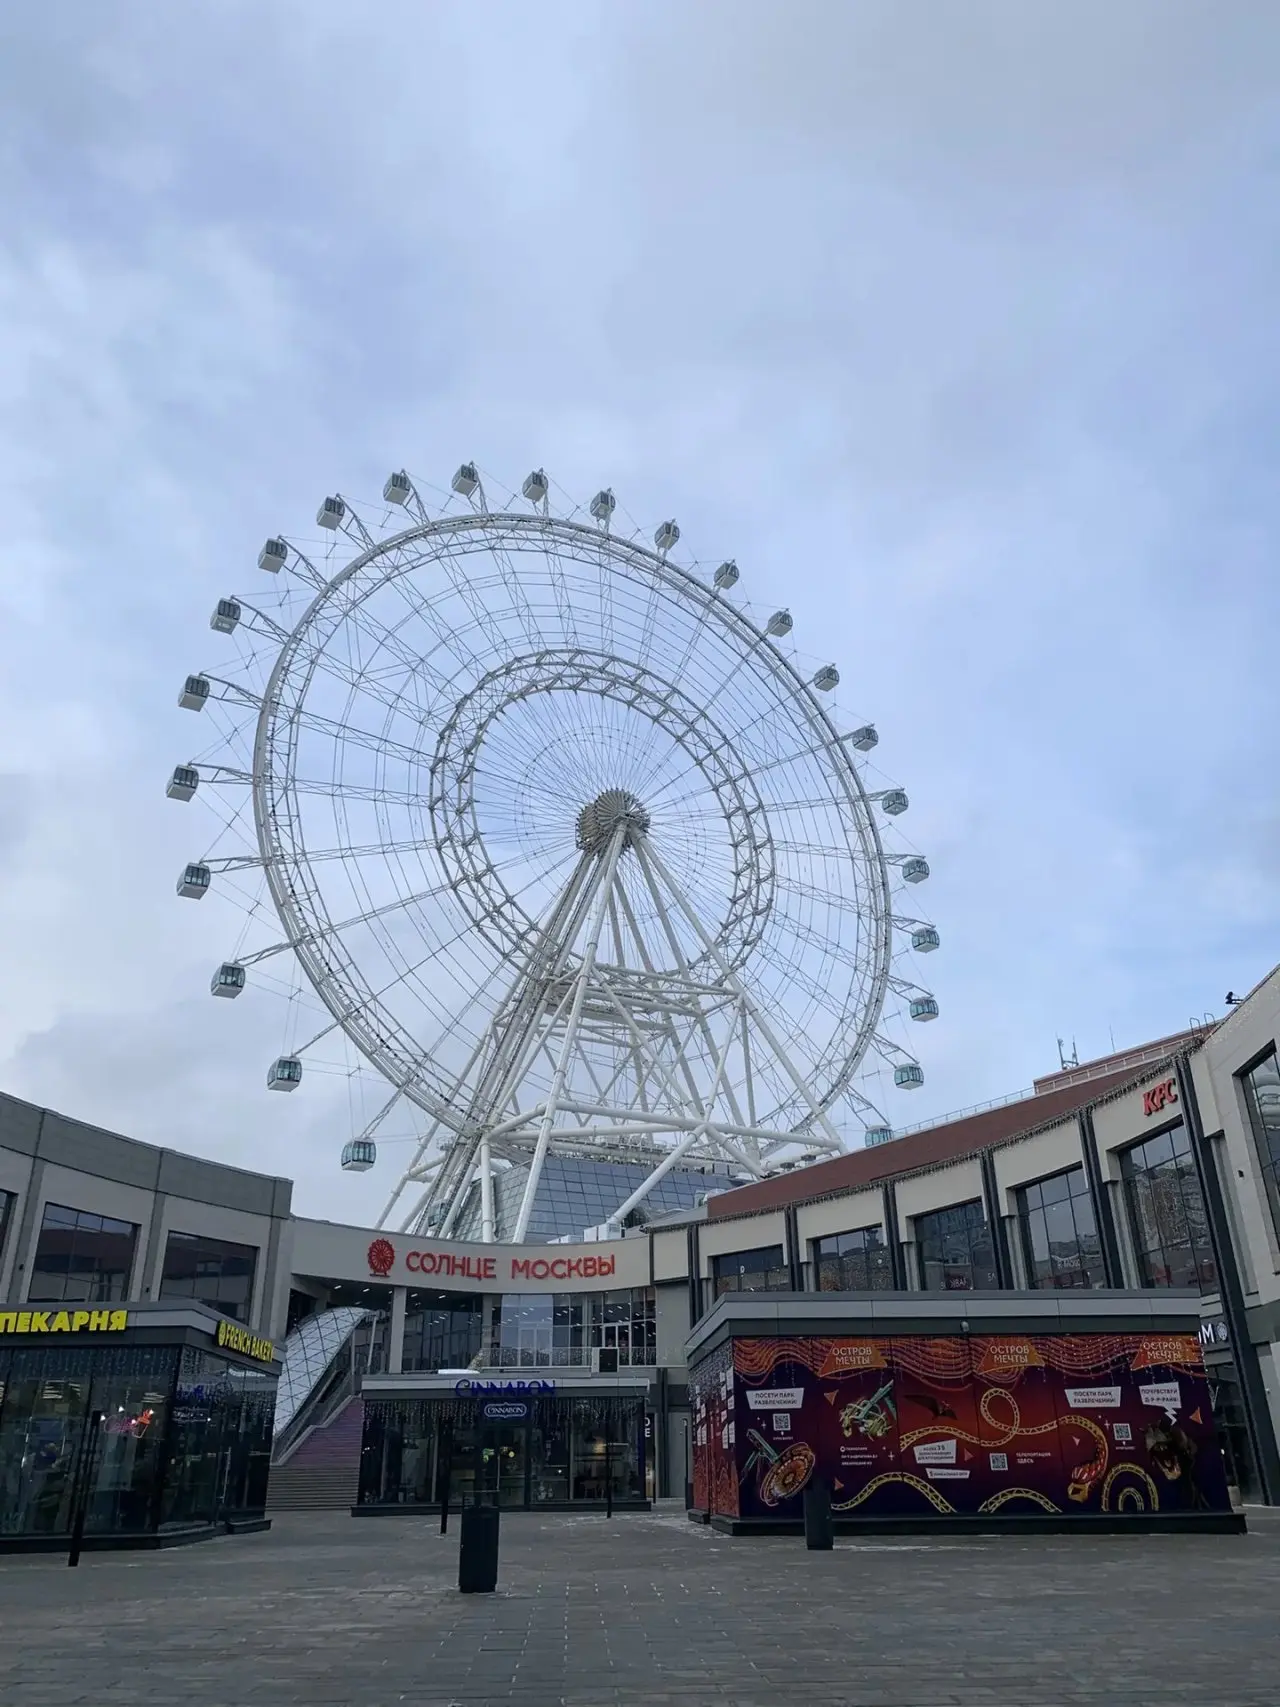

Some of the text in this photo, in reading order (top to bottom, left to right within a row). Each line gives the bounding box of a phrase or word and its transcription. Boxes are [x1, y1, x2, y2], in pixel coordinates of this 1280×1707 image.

[1143, 1078, 1178, 1116] KFC
[405, 1251, 616, 1281] СОЛНЦЕ МОСКВЫ
[0, 1310, 127, 1333] ПЕКАРНЯ
[226, 1326, 273, 1363] FRENCH BAKERY
[1142, 1341, 1182, 1351] ОСТРОВ
[832, 1346, 872, 1356] ОСТРОВ
[990, 1345, 1030, 1355] ОСТРОВ
[1147, 1350, 1182, 1360] МЕЧТЫ
[835, 1356, 871, 1365] МЕЧТЫ
[993, 1355, 1028, 1363] МЕЧТЫ
[456, 1379, 556, 1397] CINNABON
[487, 1406, 523, 1414] CINNABON
